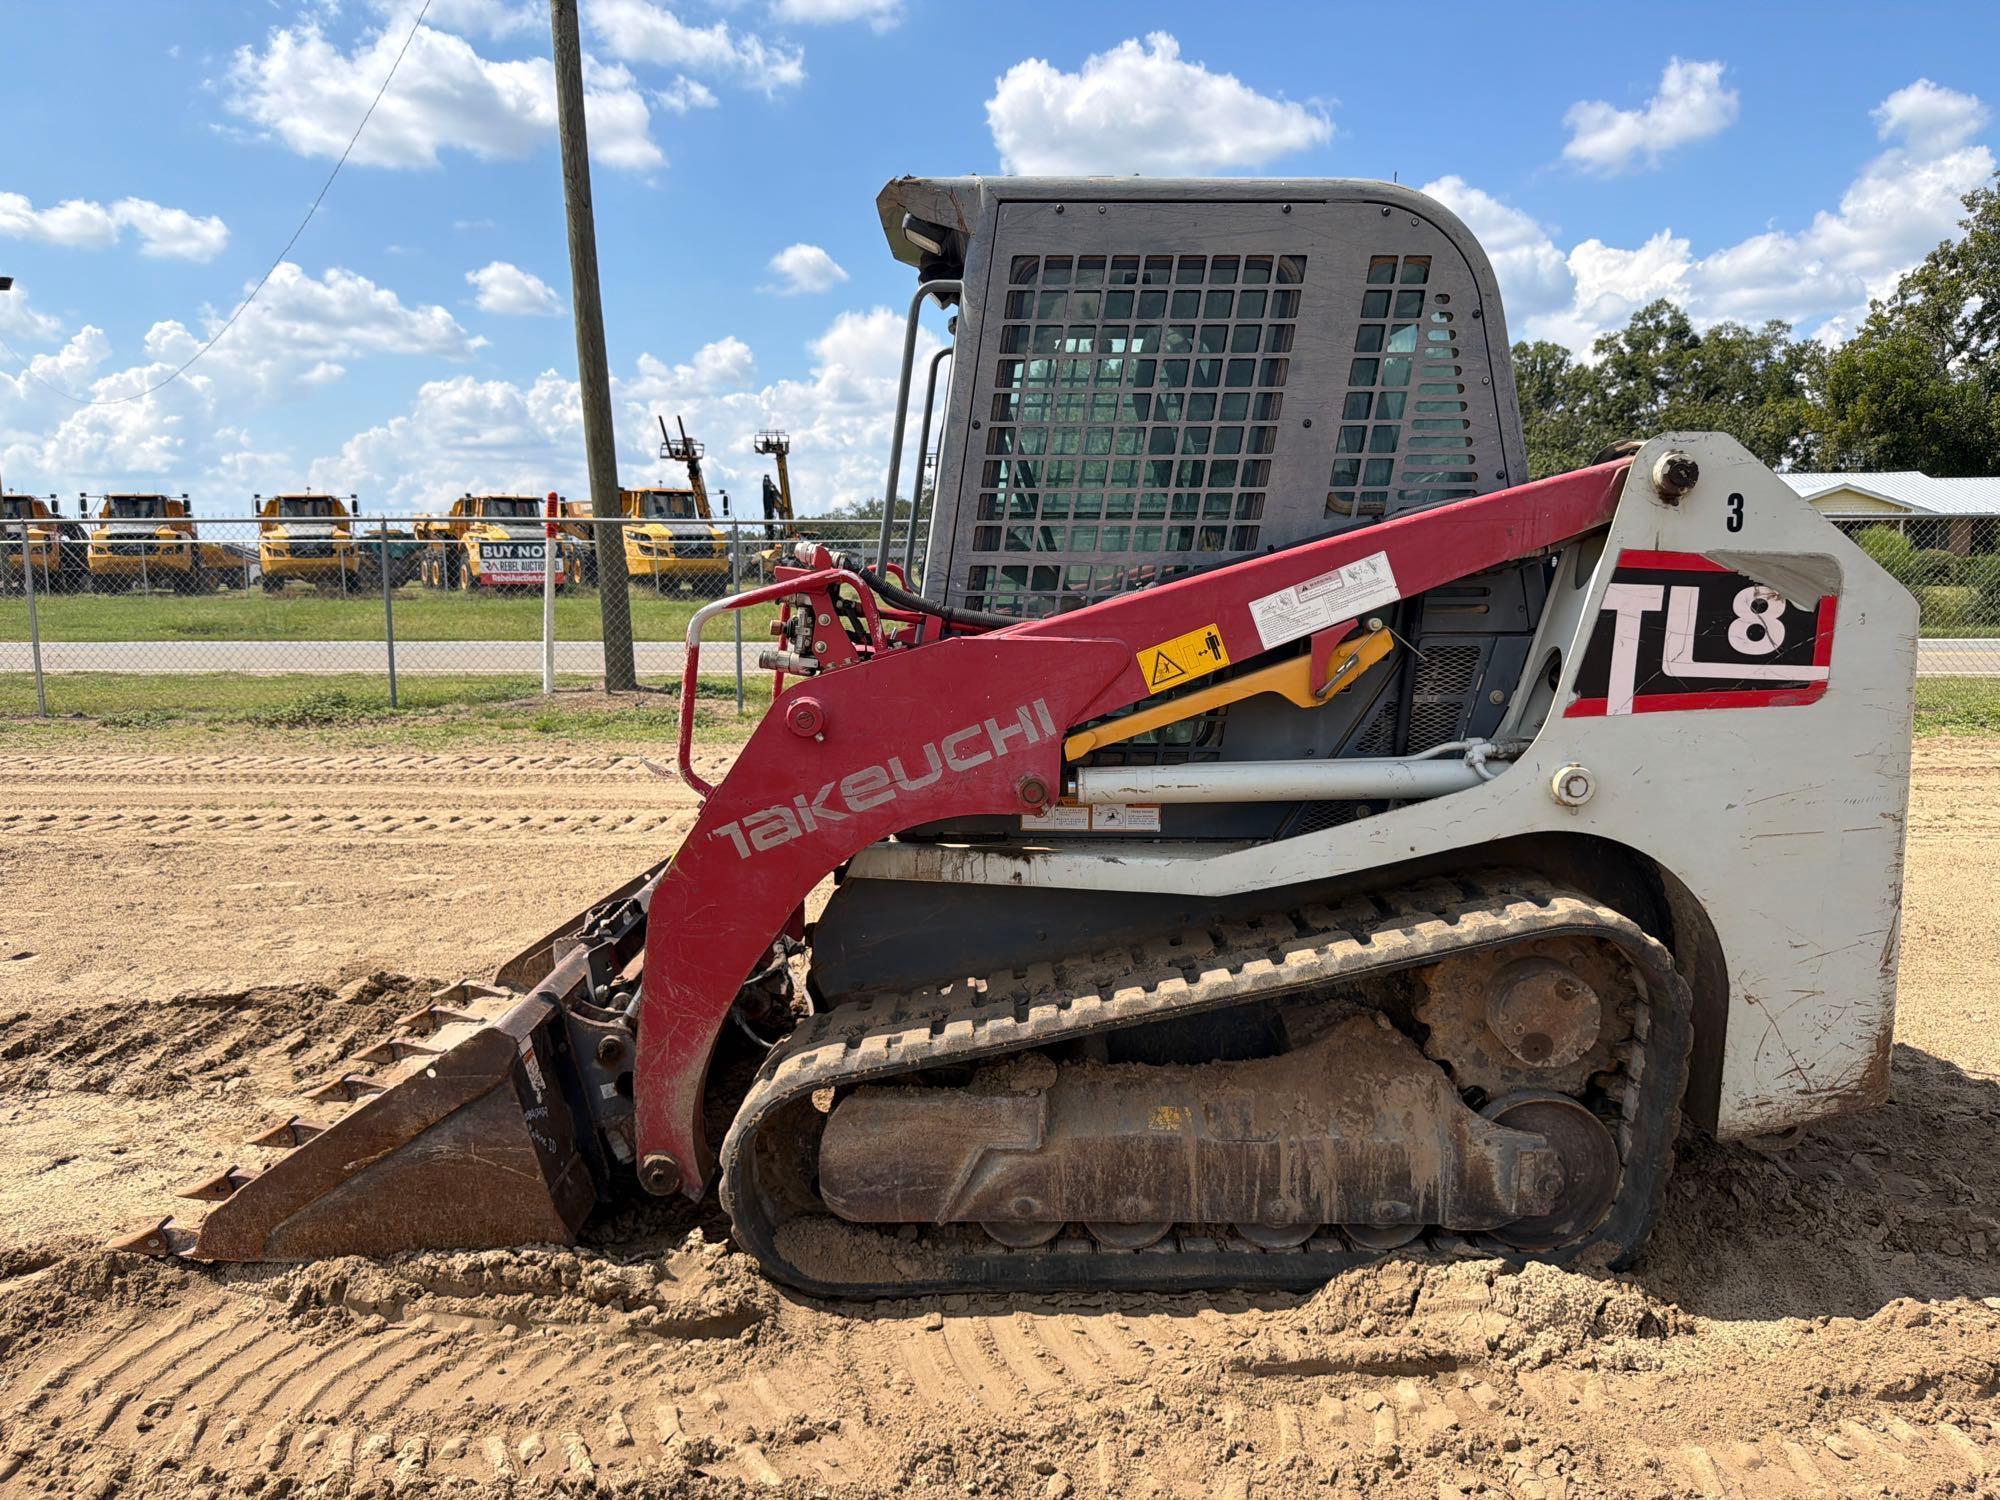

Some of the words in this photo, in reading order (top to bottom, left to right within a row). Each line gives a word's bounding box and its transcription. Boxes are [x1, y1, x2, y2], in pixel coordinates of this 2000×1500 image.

[1727, 493, 1744, 533] 3
[482, 545, 513, 557] BUY
[500, 561, 519, 571] REBEL
[521, 561, 545, 571] AUCTIO
[1600, 583, 1830, 716] TL8
[712, 698, 1057, 859] TAKEUCHI
